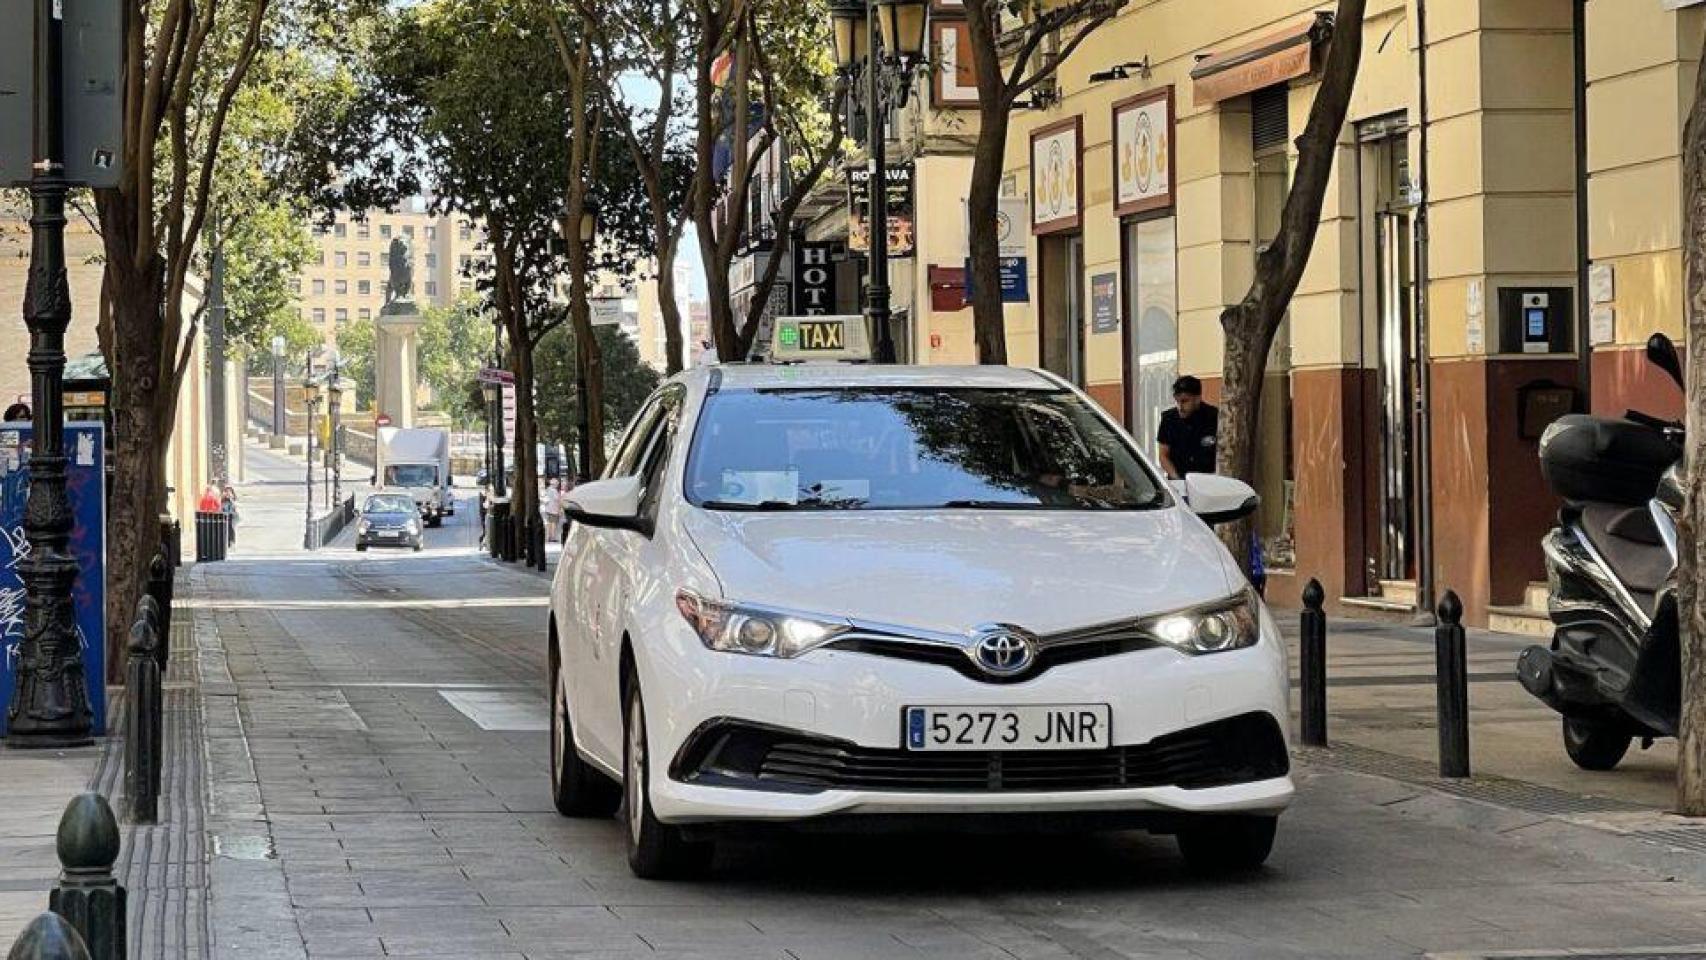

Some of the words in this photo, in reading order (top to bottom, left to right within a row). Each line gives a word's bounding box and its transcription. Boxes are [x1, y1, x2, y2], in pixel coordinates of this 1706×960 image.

[852, 169, 910, 181] ROAVA
[800, 323, 843, 348] TAXI
[931, 712, 1020, 744] 5273
[1034, 711, 1098, 743] JNR
